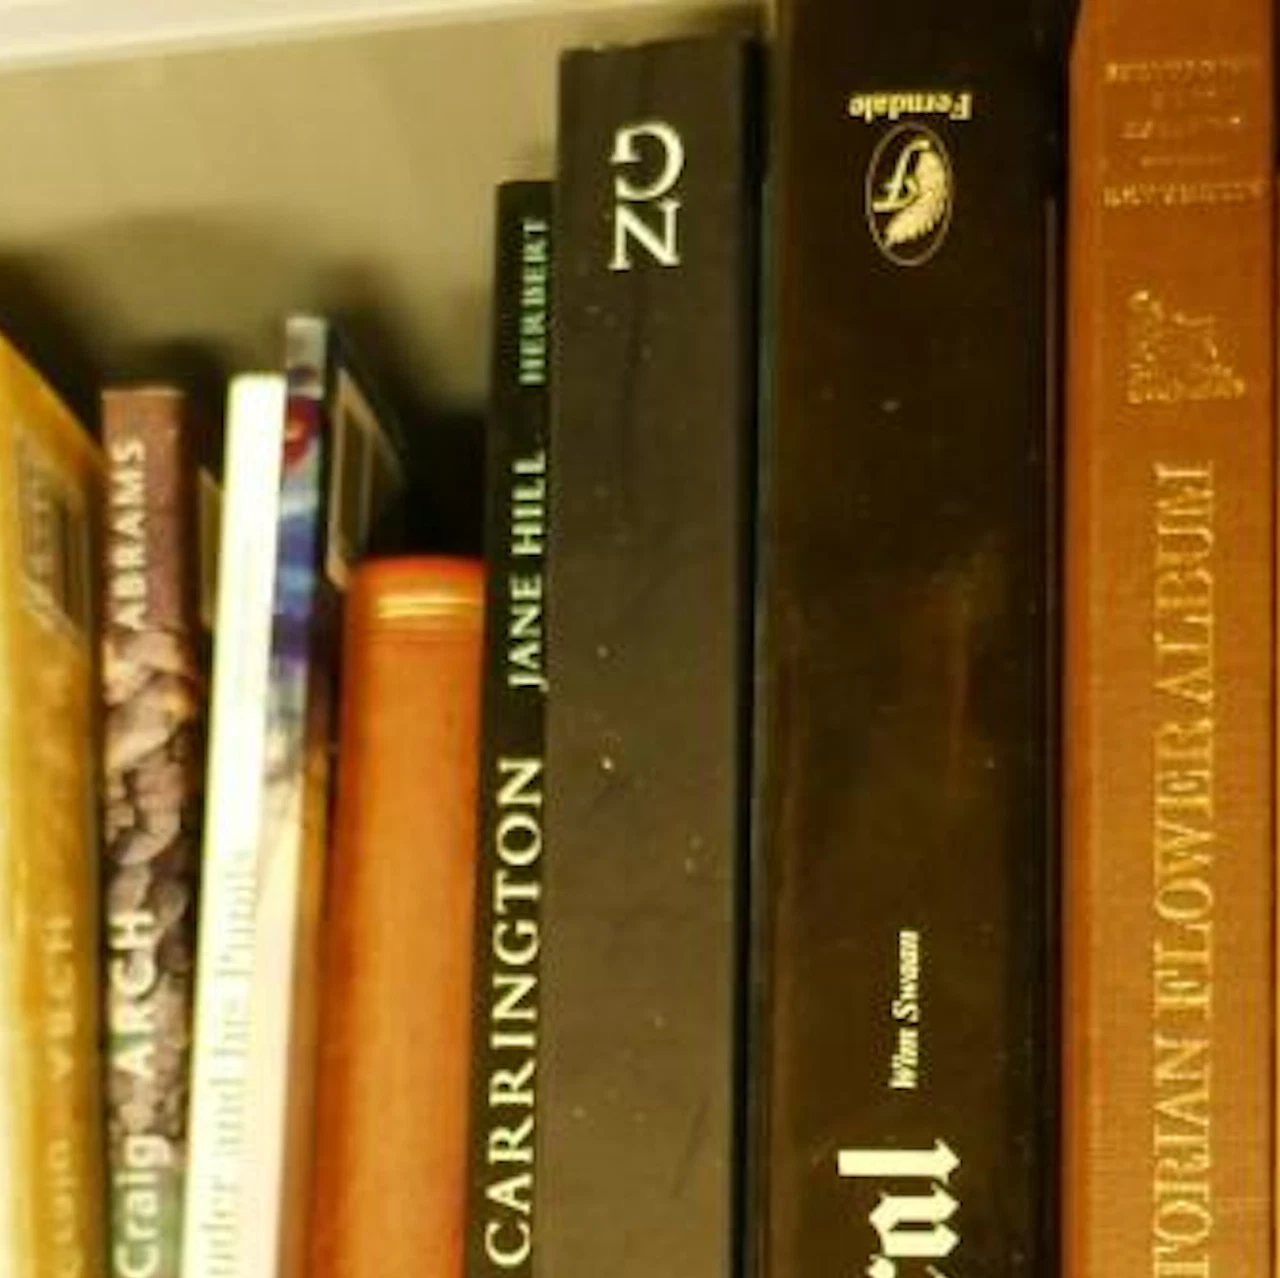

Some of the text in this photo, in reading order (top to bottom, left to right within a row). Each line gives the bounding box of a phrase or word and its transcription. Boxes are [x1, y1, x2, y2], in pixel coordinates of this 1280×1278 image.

[846, 91, 972, 126] Ferndale
[519, 215, 549, 385] HERBERT
[109, 437, 148, 632] ABRAMS
[511, 450, 547, 557] HILL
[1149, 459, 1216, 706] ALBUM
[506, 573, 550, 693] JANE
[1149, 714, 1216, 1020] FLOWER
[106, 910, 154, 1076] ARCH
[483, 756, 543, 1269] CARRINGTON
